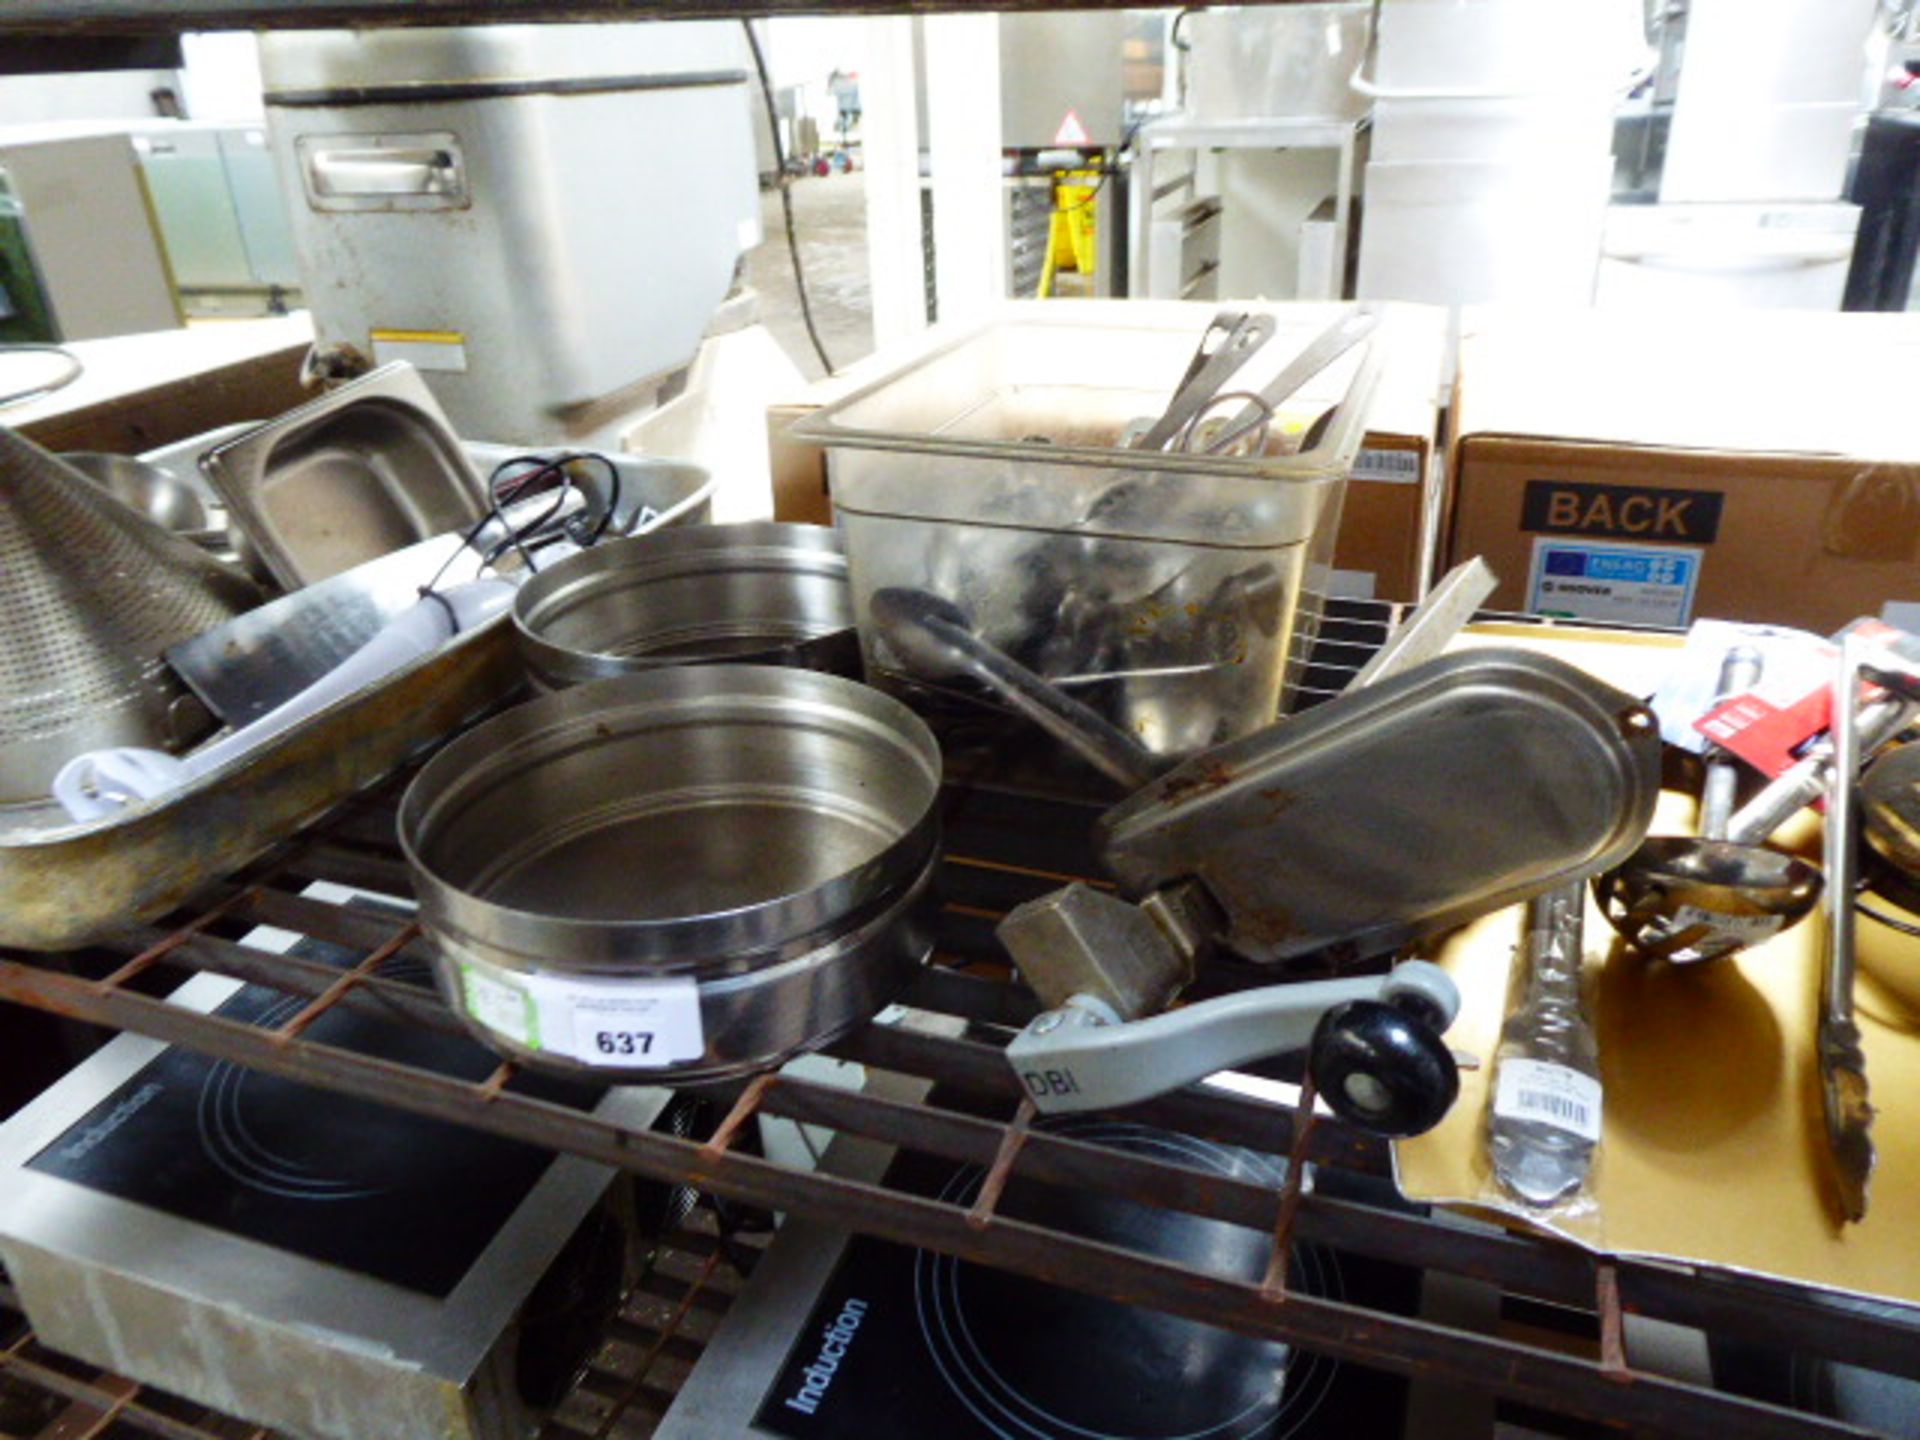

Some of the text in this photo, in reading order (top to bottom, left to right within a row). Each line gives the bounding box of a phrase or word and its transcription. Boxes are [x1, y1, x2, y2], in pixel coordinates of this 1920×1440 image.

[1547, 489, 1693, 536] BACK
[595, 1031, 655, 1055] 637
[1024, 1068, 1080, 1096] DBI
[785, 1297, 869, 1415] Induction
